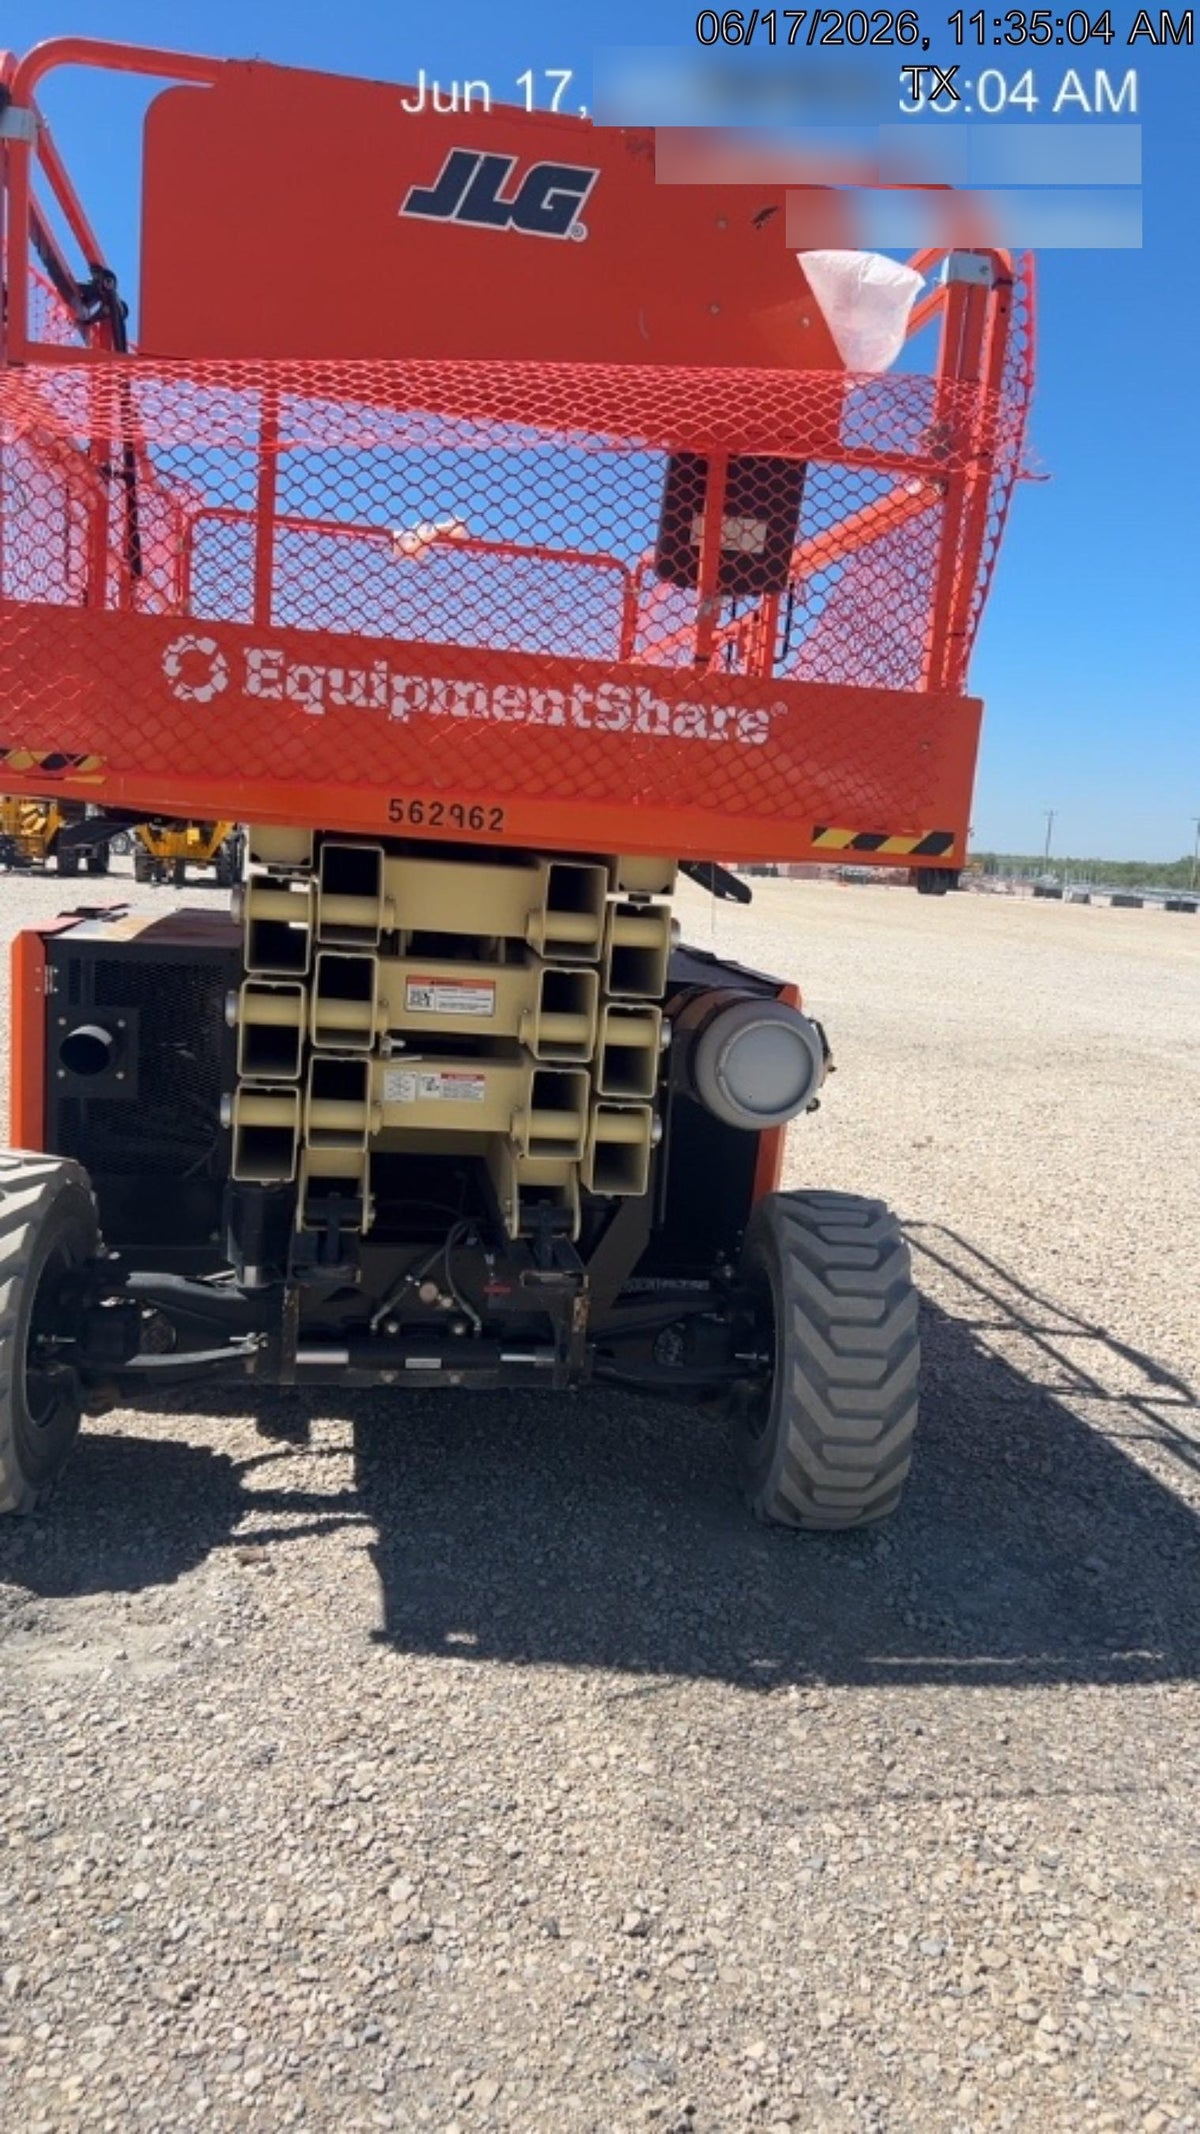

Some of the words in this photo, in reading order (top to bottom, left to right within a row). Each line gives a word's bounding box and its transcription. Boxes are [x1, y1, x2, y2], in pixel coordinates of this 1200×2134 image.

[399, 147, 600, 240] JLG
[242, 647, 770, 744] EquipmentShare
[388, 798, 504, 832] 562962
